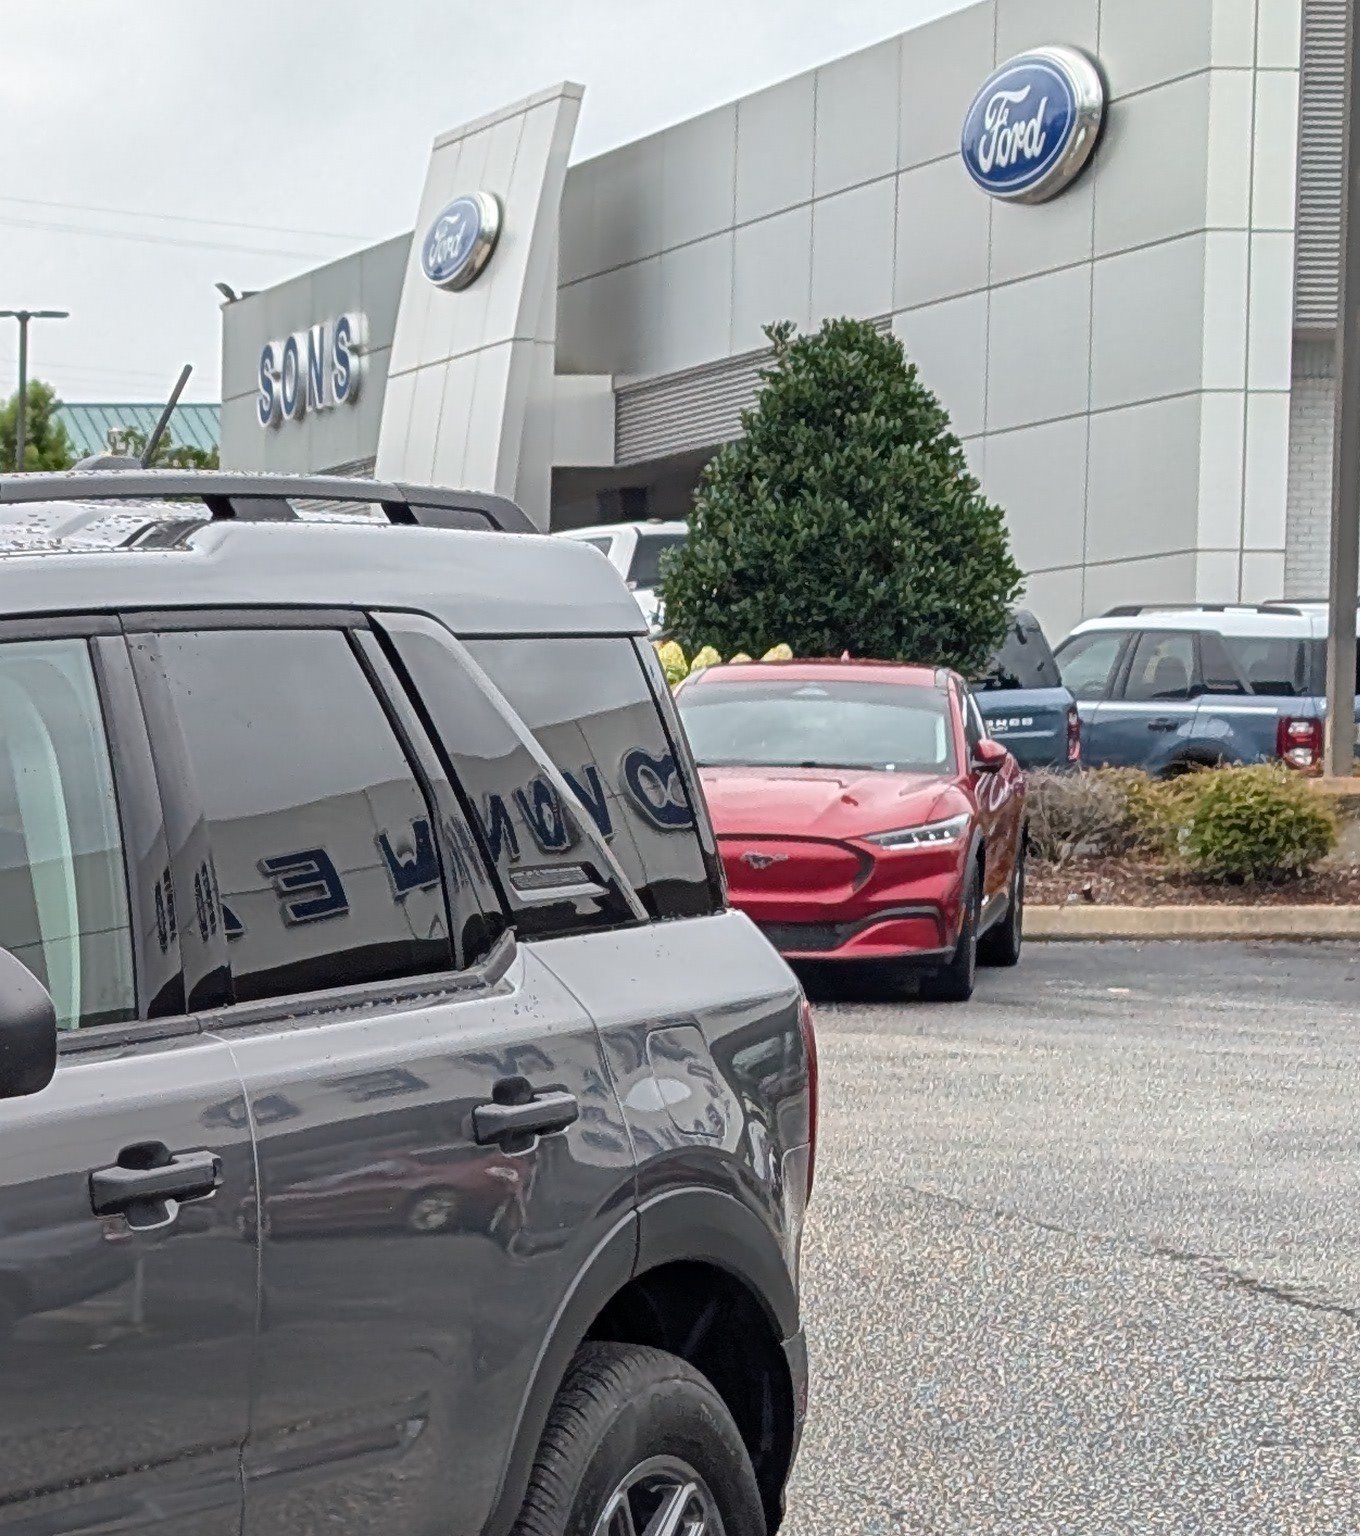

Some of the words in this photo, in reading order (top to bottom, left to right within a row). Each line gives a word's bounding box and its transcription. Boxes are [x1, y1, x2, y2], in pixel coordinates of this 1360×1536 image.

[978, 84, 1049, 174] Ford
[428, 212, 468, 268] Ford
[257, 315, 353, 427] SONS
